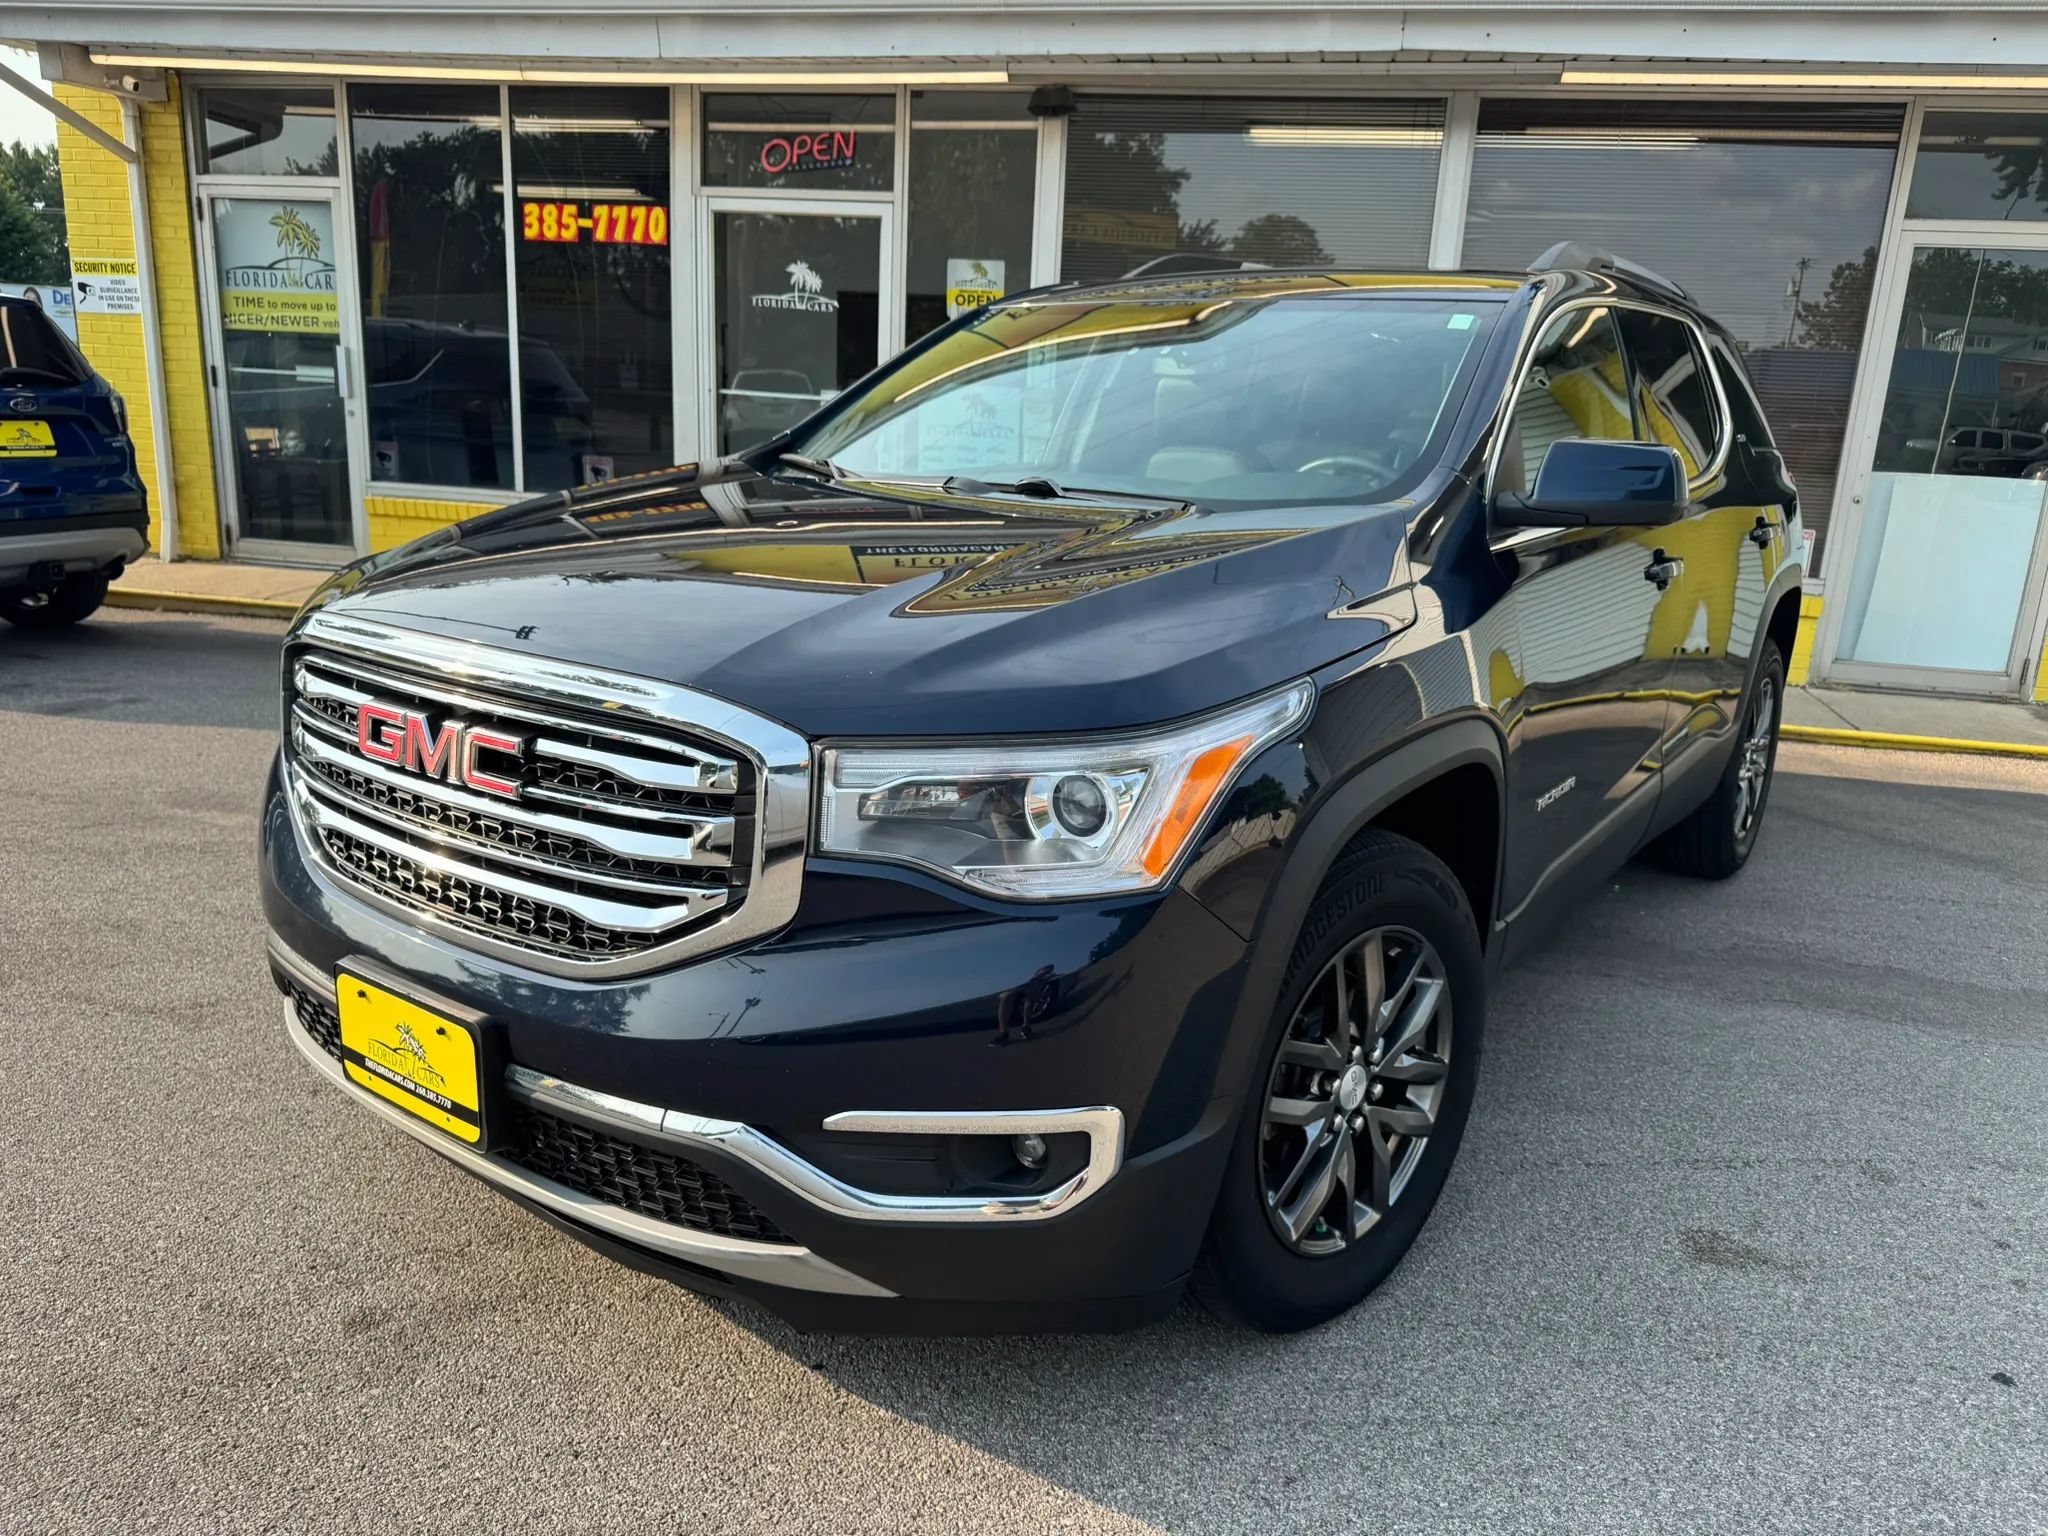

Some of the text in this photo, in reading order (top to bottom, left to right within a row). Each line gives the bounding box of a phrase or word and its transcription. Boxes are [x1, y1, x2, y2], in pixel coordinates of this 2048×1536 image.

[760, 129, 856, 174] OPEN
[523, 202, 666, 243] 385-7770
[74, 262, 136, 274] SECURITY NOTICE
[225, 270, 288, 288] FLORIDA
[99, 287, 138, 295] SURVEILLANCE
[233, 296, 336, 312] TIME to move up to
[752, 296, 834, 313] FLORIDA CARS
[955, 294, 996, 307] OPEN
[223, 312, 319, 328] NICER/NEWER
[357, 703, 521, 798] GMC
[368, 1040, 440, 1089] FLORIDA CARS
[364, 1057, 452, 1110] THEFLORIDACARS.COM 260.385.7770
